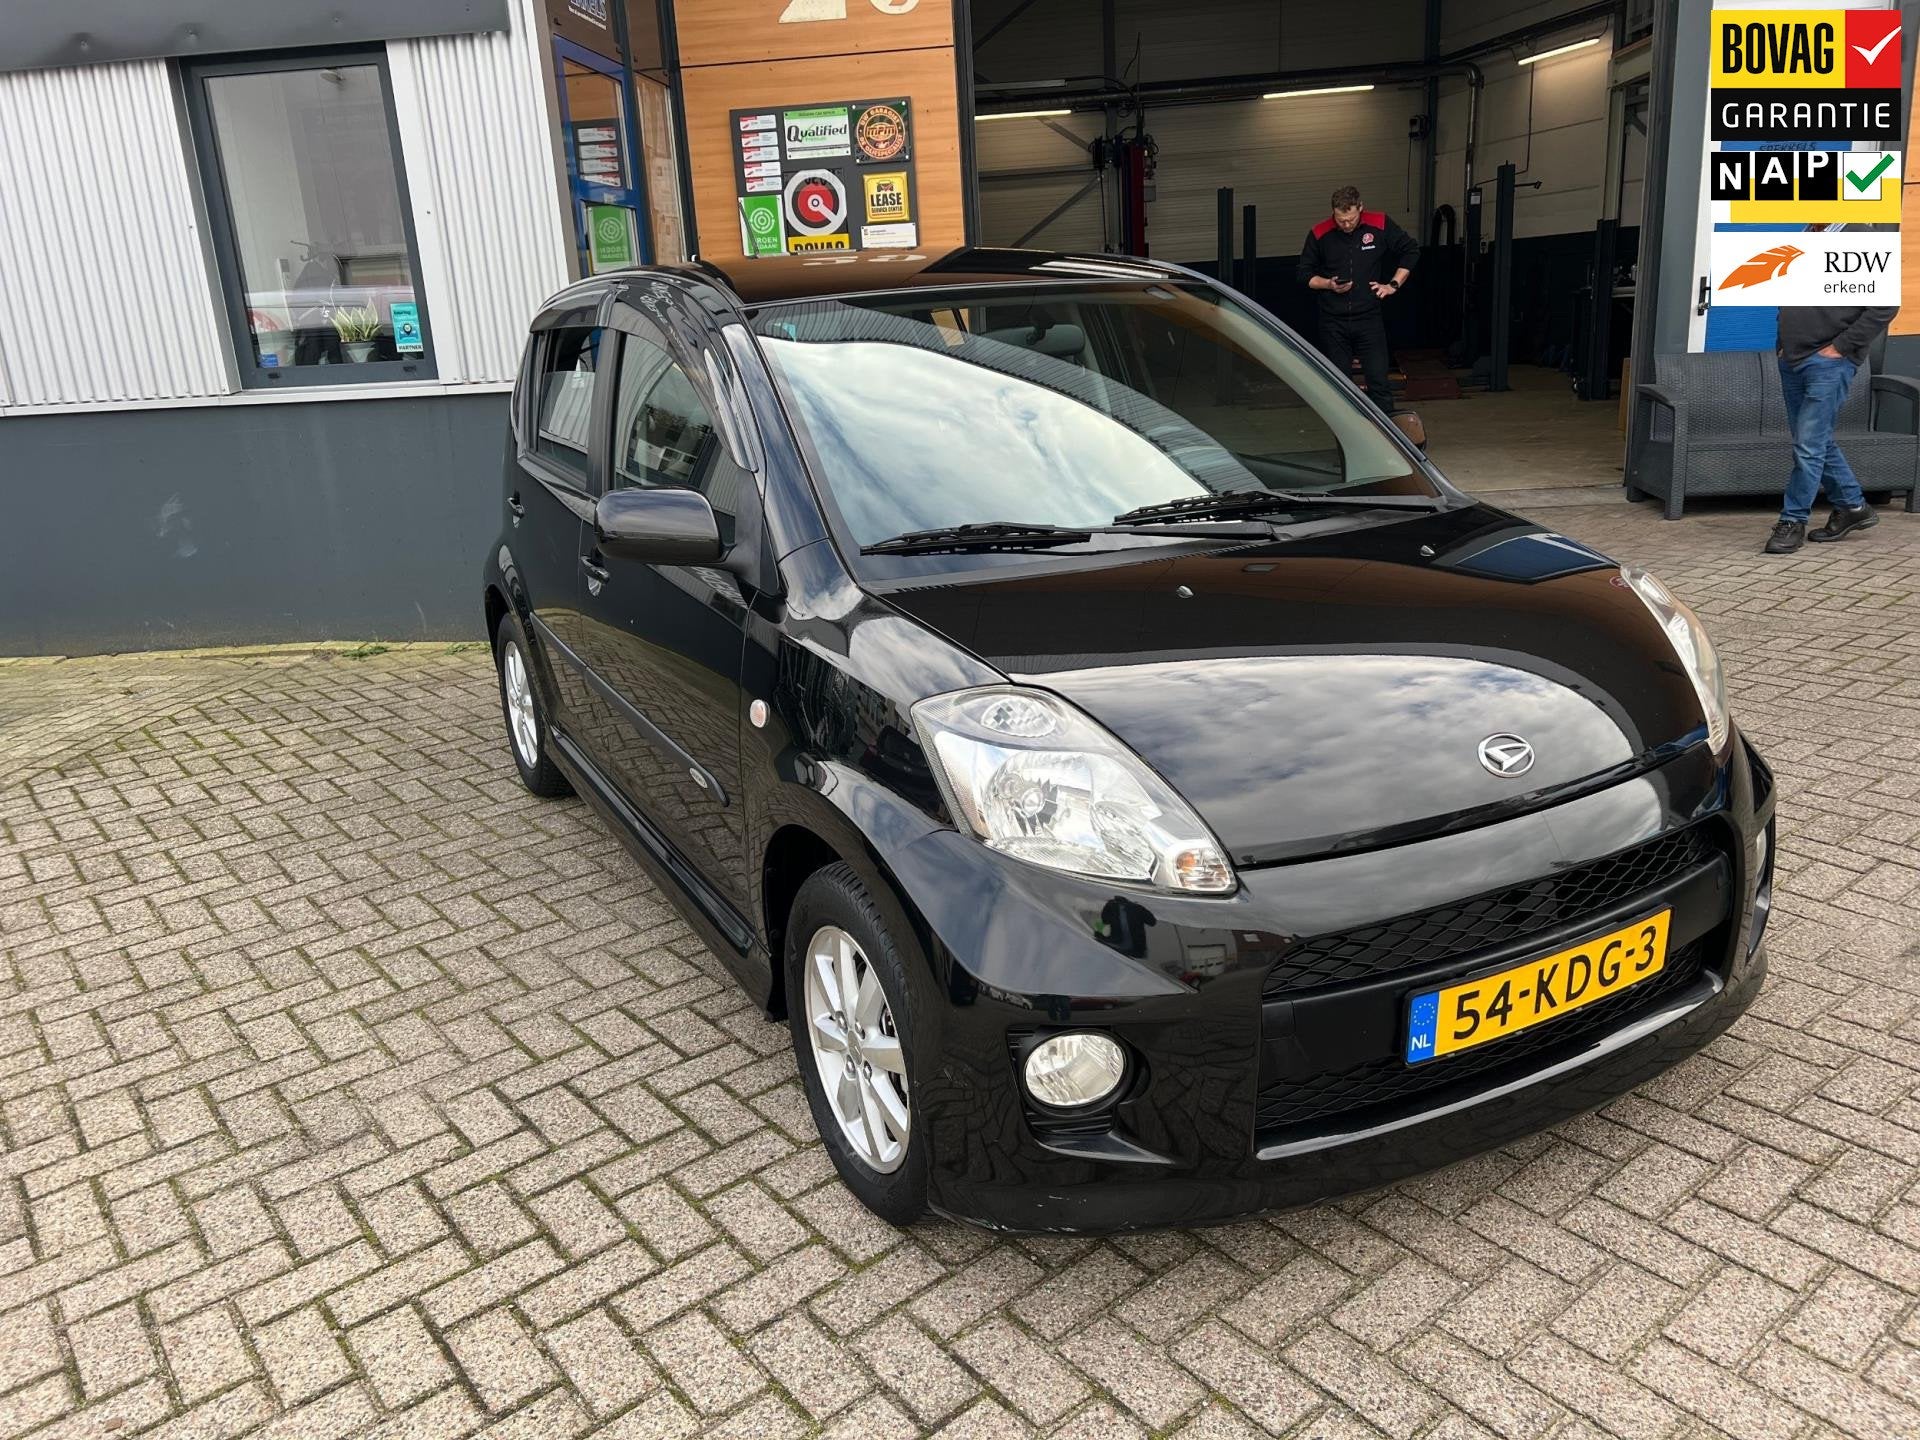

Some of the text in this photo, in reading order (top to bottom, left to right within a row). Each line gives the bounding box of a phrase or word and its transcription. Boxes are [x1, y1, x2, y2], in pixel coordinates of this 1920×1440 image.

[787, 124, 847, 143] Qualified
[870, 192, 902, 207] LEASE
[756, 236, 778, 244] ROEN
[1453, 925, 1657, 1040] 54-KDG-3
[1411, 1034, 1432, 1051] NL
